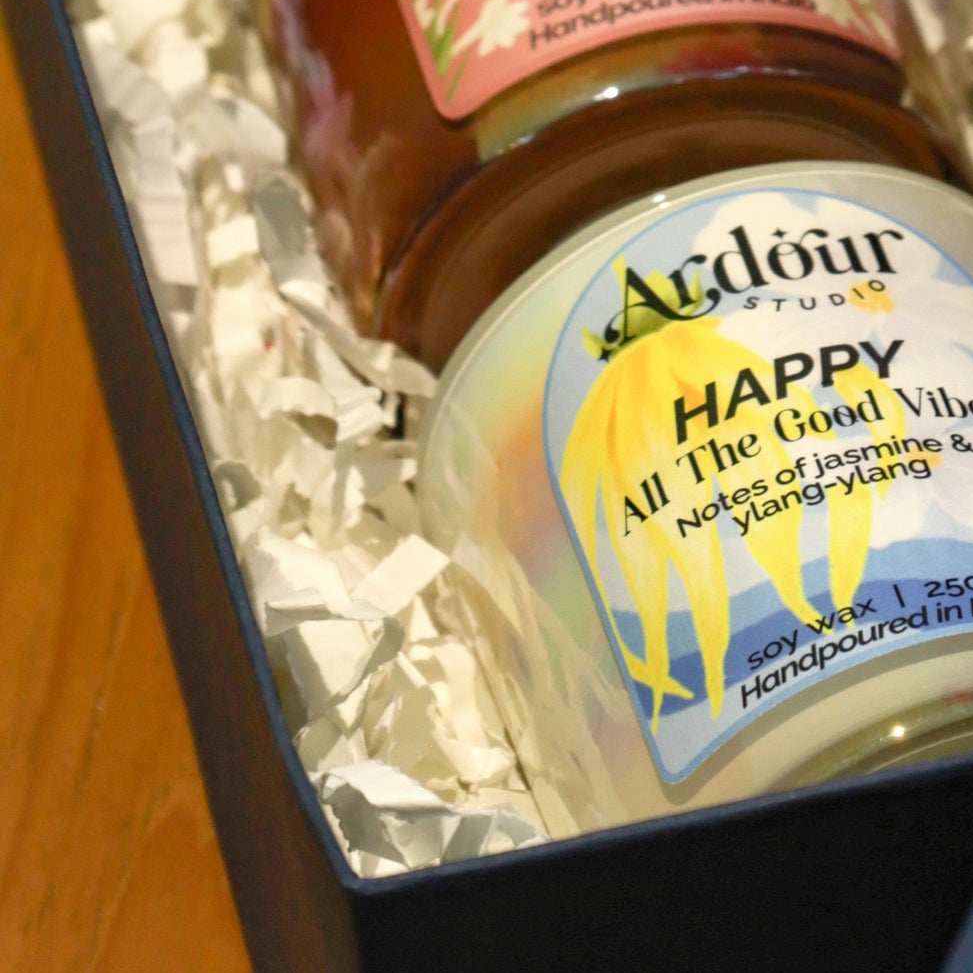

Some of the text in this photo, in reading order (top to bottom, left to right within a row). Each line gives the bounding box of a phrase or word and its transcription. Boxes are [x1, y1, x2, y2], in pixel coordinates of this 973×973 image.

[743, 279, 886, 312] STUDIO
[672, 338, 905, 446] HAPPY
[622, 471, 672, 537] All
[675, 433, 763, 485] The
[773, 388, 885, 443] Good
[675, 480, 769, 539] Notes
[774, 456, 808, 486] of
[808, 434, 944, 480] jasmine
[732, 458, 931, 536] ylang-ylang
[740, 604, 928, 710] Handpoured
[936, 602, 963, 624] in
[747, 627, 800, 671] soy
[806, 597, 878, 635] wax
